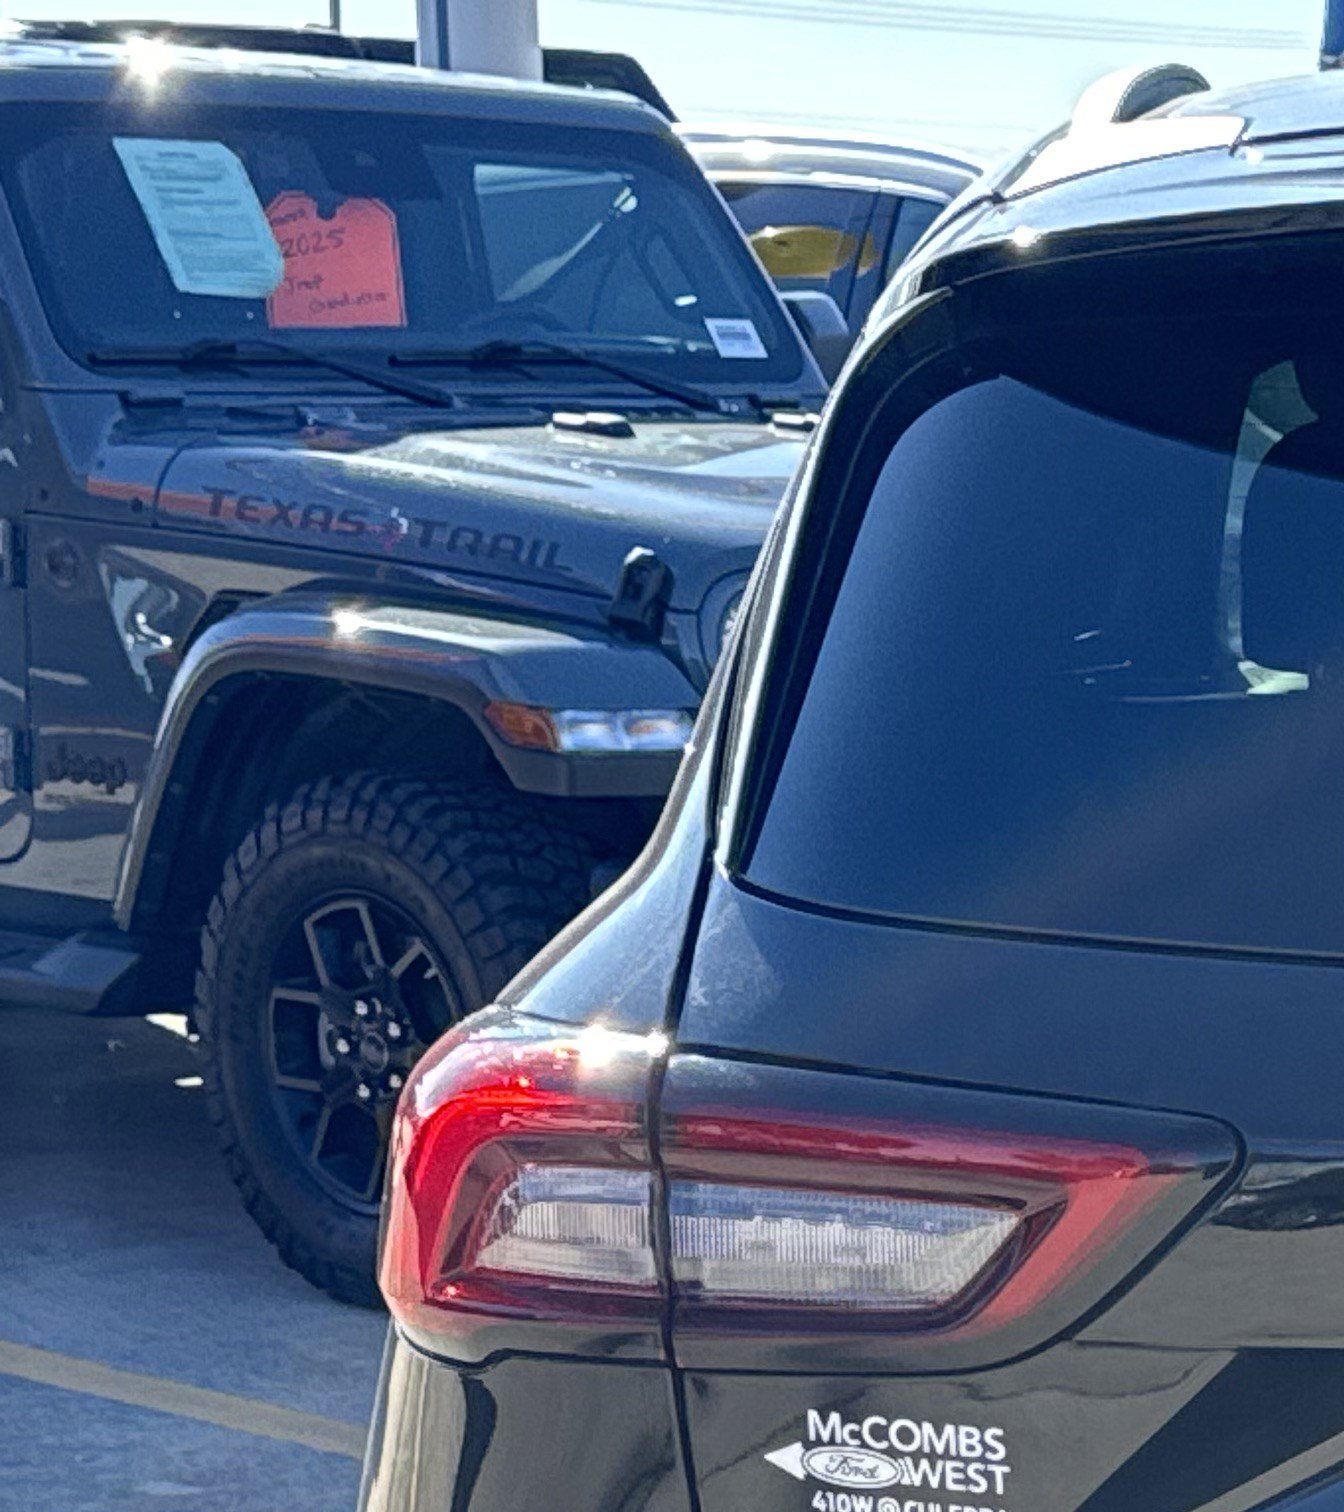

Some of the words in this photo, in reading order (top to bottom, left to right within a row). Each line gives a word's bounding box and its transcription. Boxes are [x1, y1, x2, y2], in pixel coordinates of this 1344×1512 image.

[282, 228, 346, 258] 2025
[201, 485, 367, 536] TEXAS
[414, 517, 573, 573] TRAIL
[807, 1408, 1006, 1462] McCOMBS
[824, 1454, 880, 1479] Ford
[905, 1456, 1012, 1495] WEST
